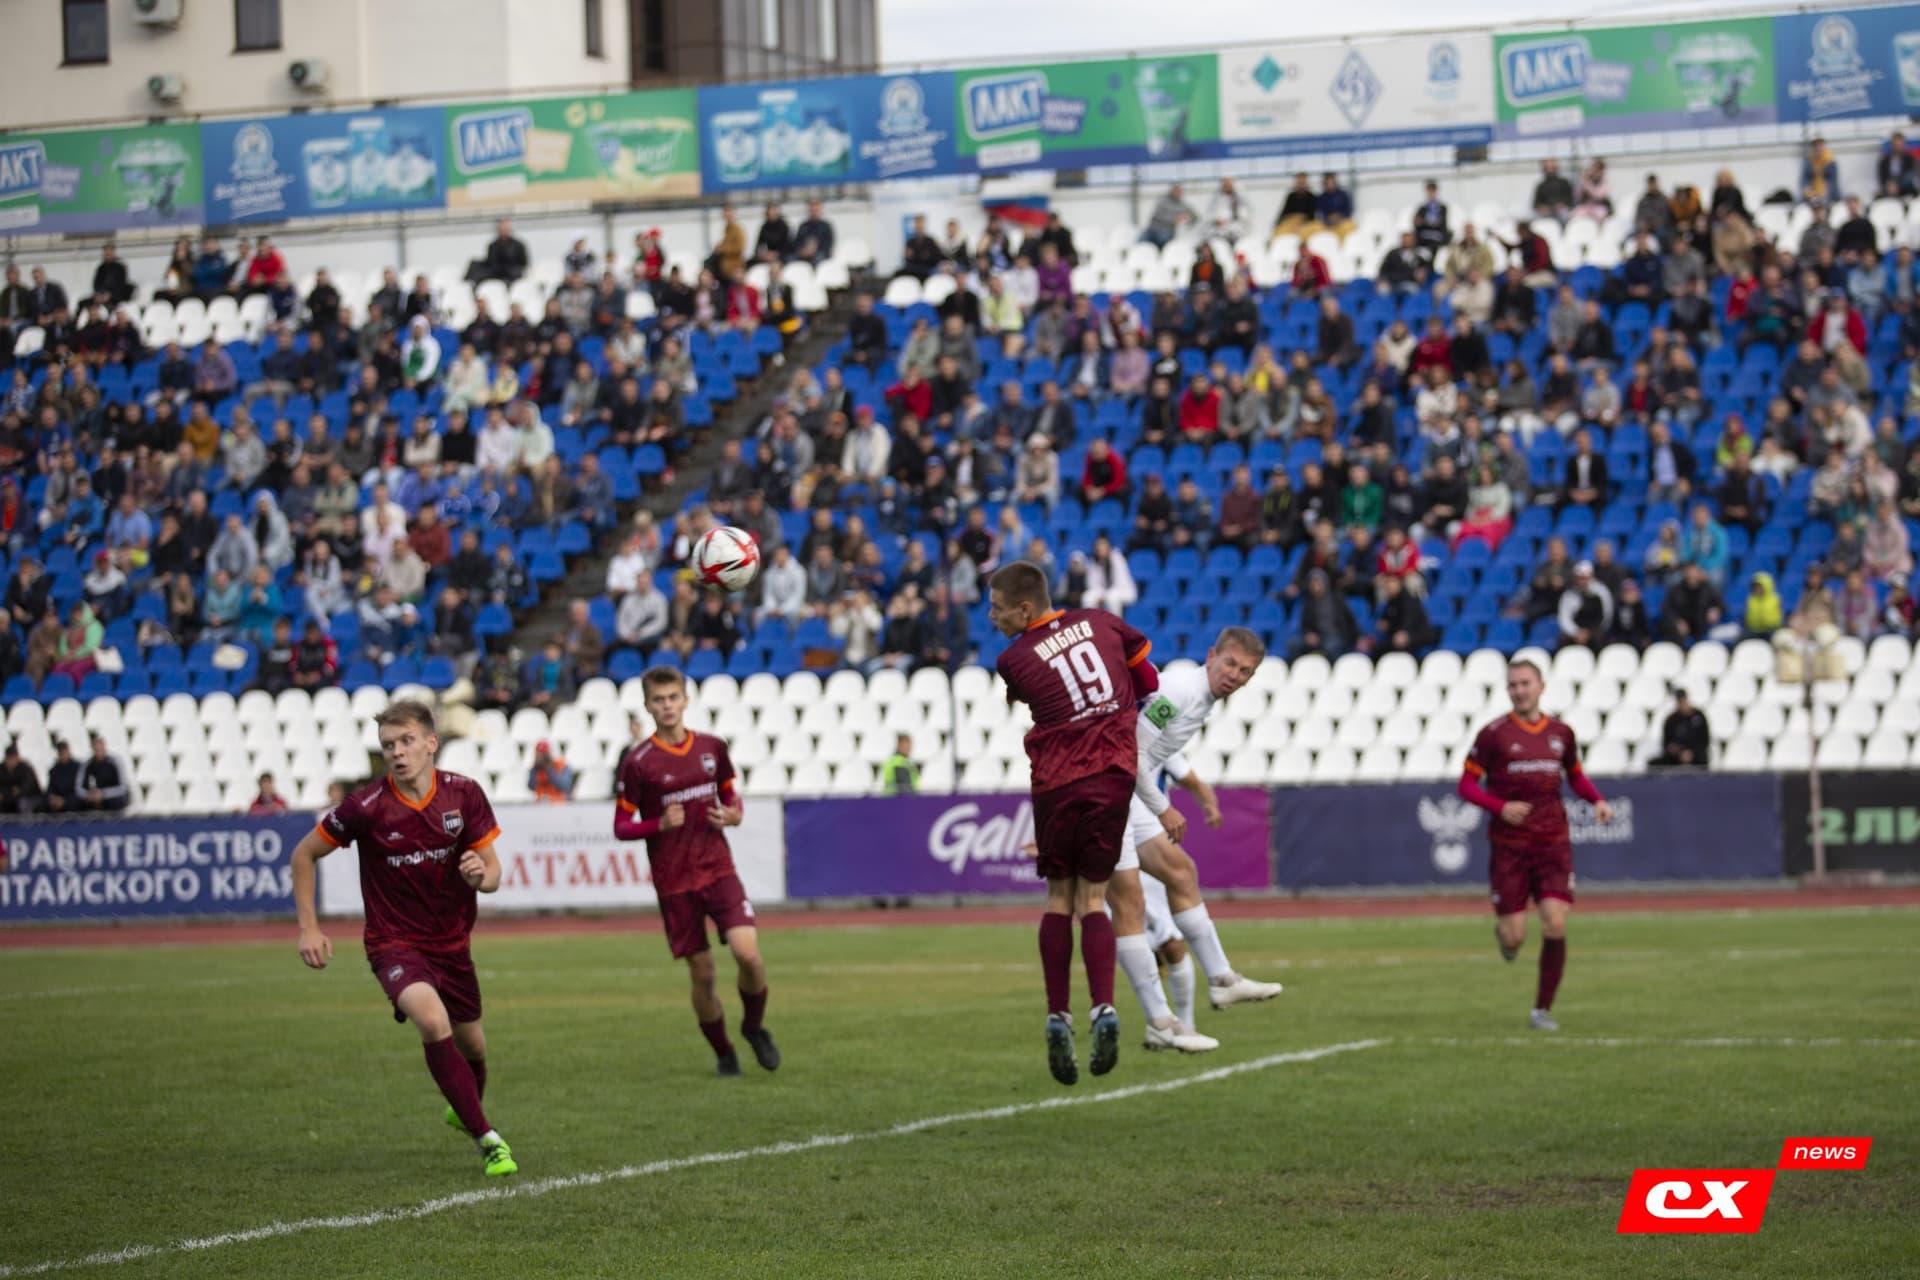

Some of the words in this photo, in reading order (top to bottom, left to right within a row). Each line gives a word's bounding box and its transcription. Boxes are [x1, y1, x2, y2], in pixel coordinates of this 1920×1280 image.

[1034, 620, 1094, 662] ШИБАЕВ
[1049, 640, 1114, 712] 19
[3, 829, 282, 871] РАВИТЕЛЬСТВО
[504, 851, 652, 886] АТАМ
